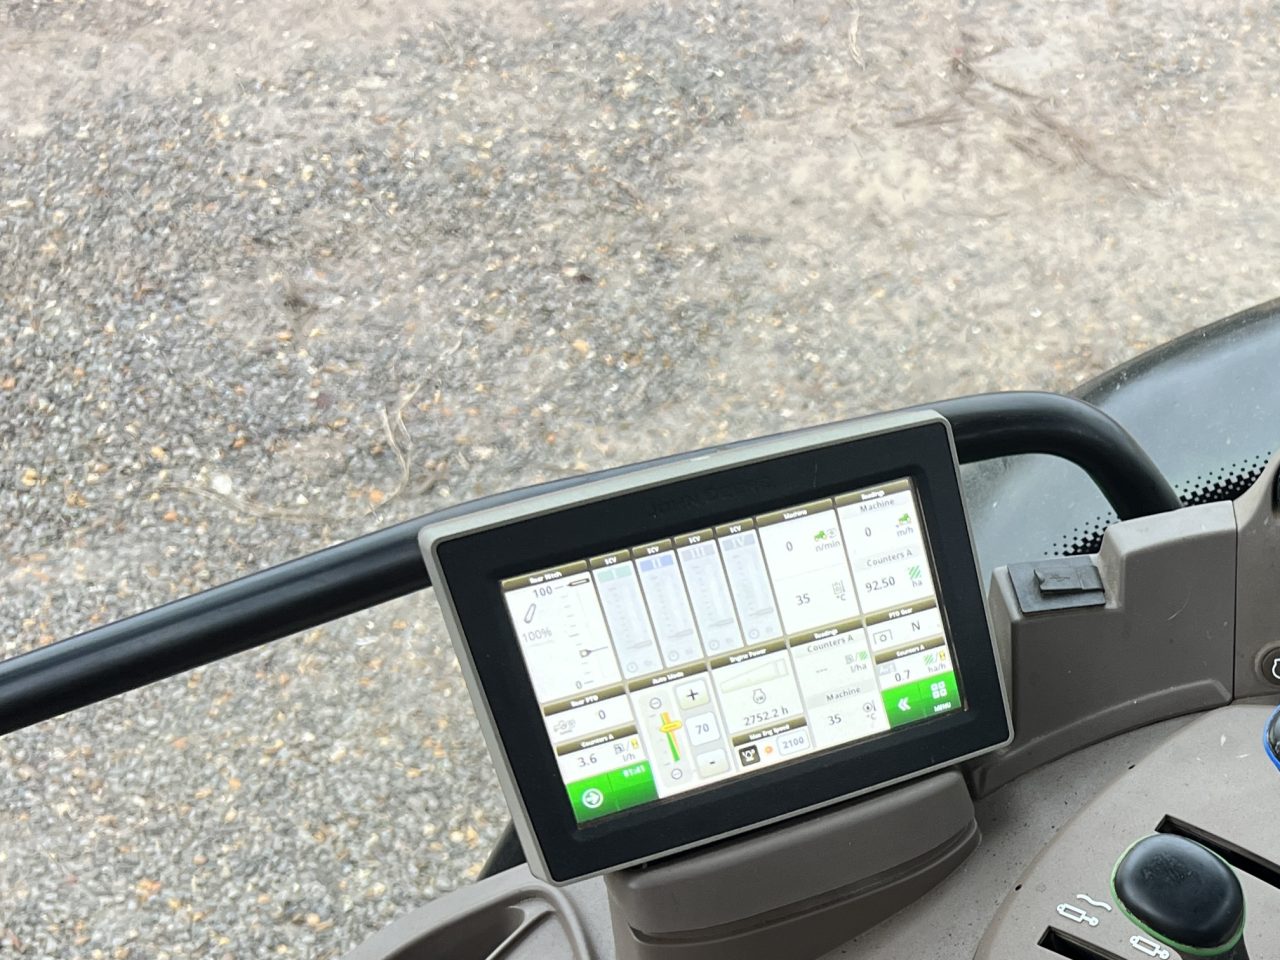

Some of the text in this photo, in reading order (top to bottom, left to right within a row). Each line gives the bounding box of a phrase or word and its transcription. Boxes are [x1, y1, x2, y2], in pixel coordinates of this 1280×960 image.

[859, 500, 895, 513] Machine
[864, 527, 872, 537] 0
[785, 541, 794, 552] 0
[815, 540, 841, 552] n/min
[866, 549, 912, 567] Counters A
[865, 576, 895, 592] 92.50
[912, 579, 923, 588] ha
[533, 585, 553, 598] 100
[796, 593, 811, 606] 35
[911, 621, 920, 632] N
[522, 627, 552, 643] 100%
[807, 634, 854, 653] Counters A
[894, 669, 911, 682] 0.7
[575, 680, 583, 689] 0
[826, 687, 860, 701] Machine
[598, 709, 606, 720] 0
[743, 706, 789, 726] 2752.2 h
[828, 714, 842, 726] 35
[695, 722, 710, 735] 70
[782, 736, 805, 749] 2100
[577, 754, 598, 768] 3.6
